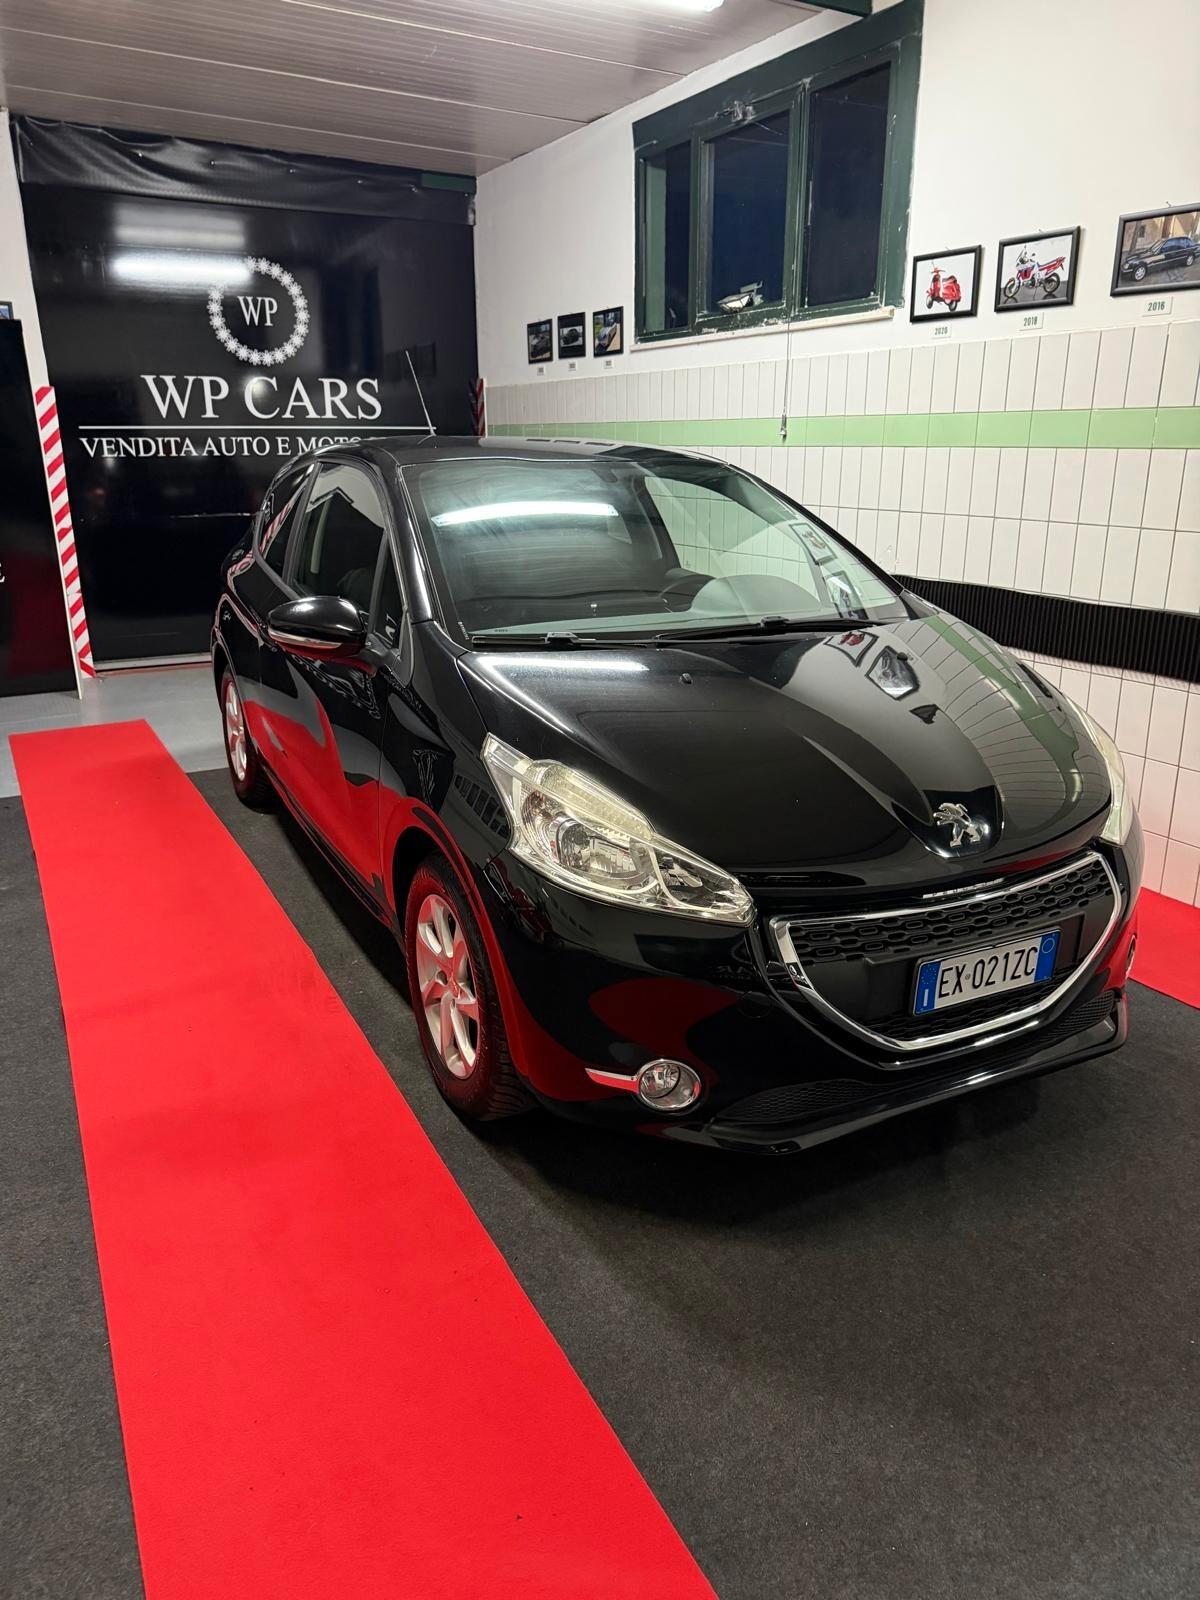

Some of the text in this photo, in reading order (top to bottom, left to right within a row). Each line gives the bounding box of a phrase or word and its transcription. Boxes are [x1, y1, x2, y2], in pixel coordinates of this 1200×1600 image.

[237, 295, 278, 327] WP
[1147, 300, 1165, 312] 2016
[140, 374, 383, 420] WP CARS
[79, 436, 362, 458] VENDITA AUTO E MO
